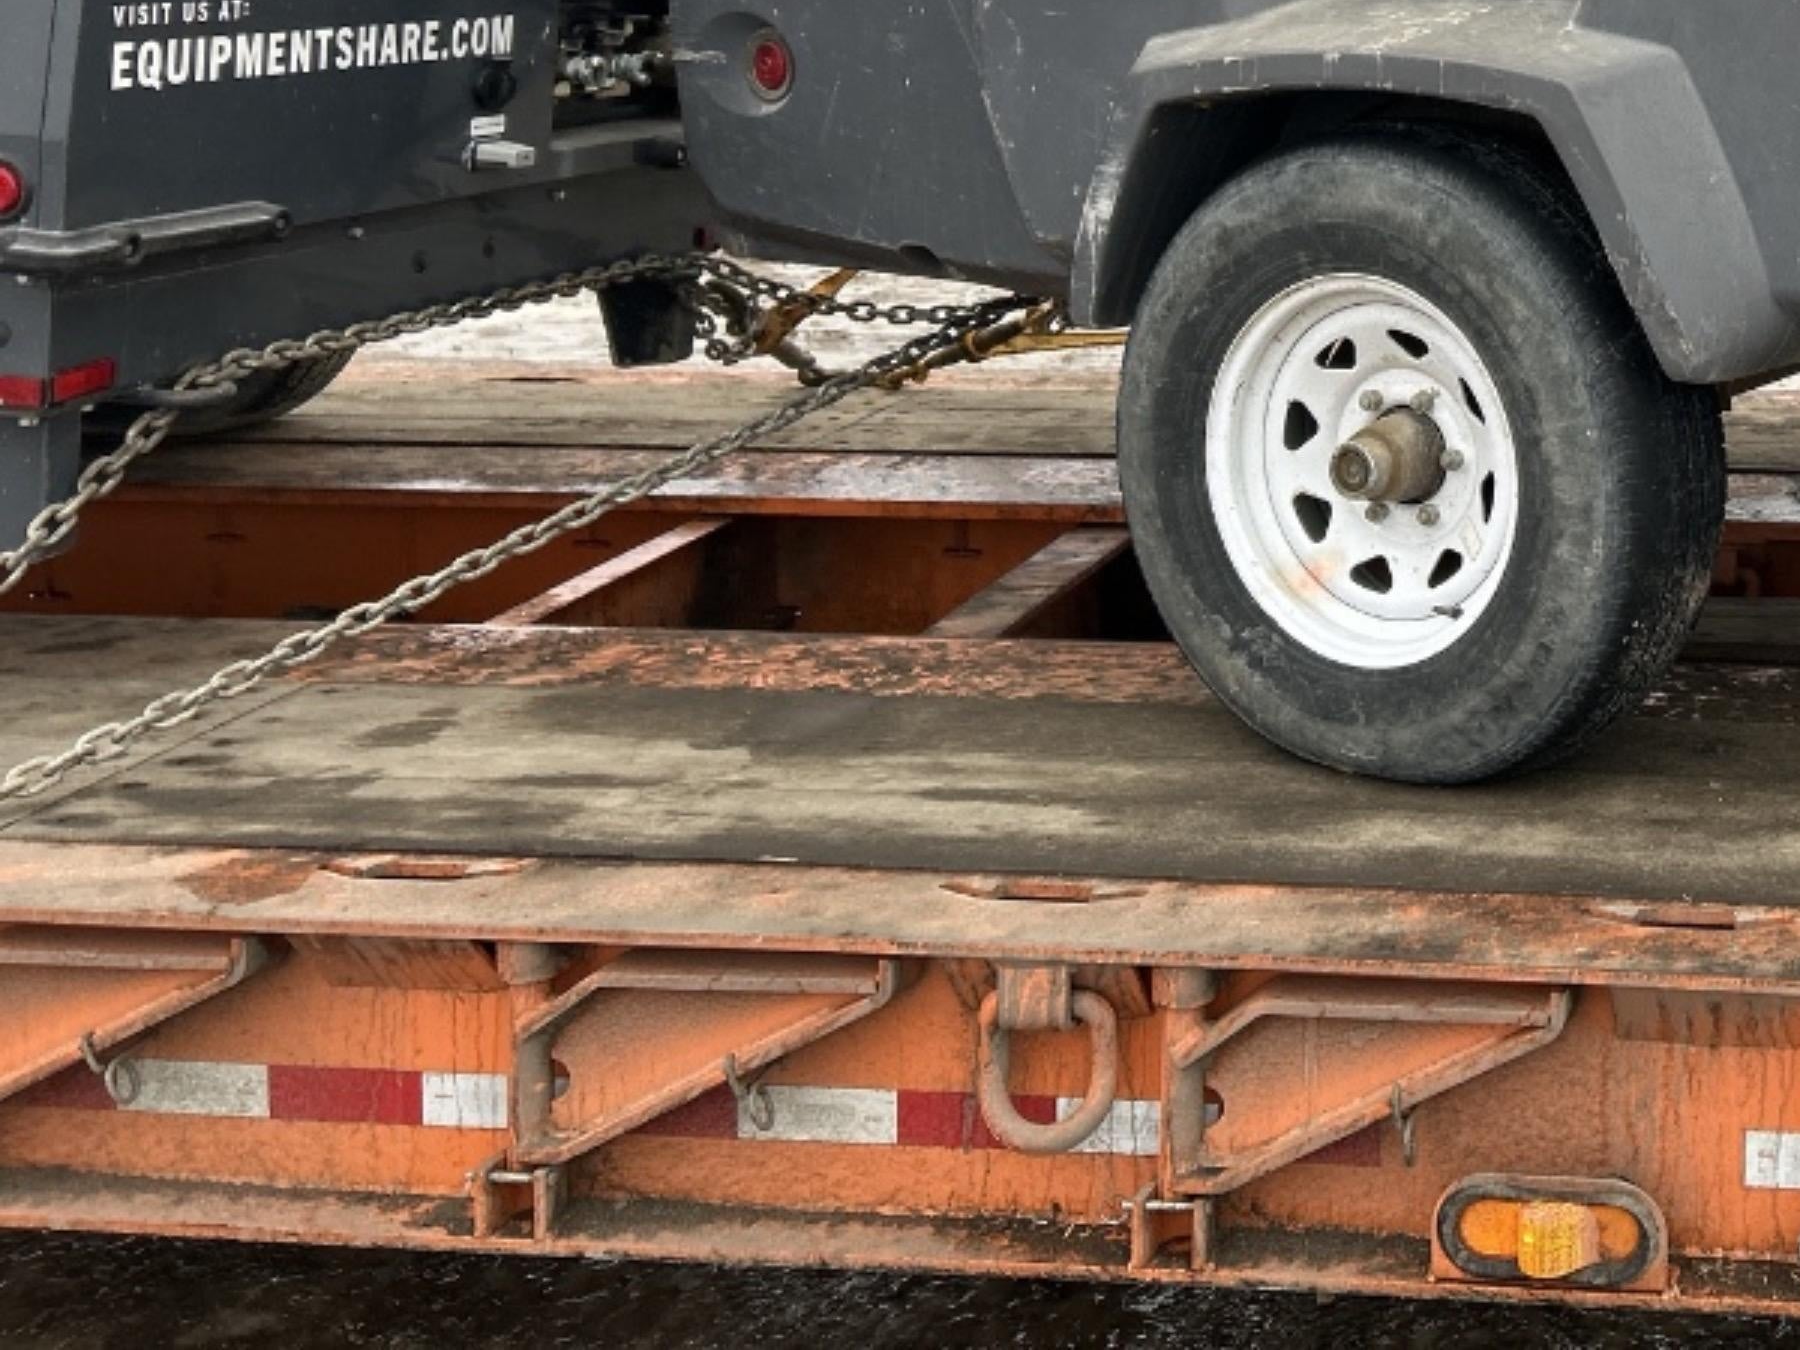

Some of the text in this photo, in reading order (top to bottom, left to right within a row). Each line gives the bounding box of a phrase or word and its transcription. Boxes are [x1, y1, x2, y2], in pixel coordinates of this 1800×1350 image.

[112, 0, 250, 27] VISIT US AT:
[110, 15, 515, 91] EQUIPMENTSHARE.COM
